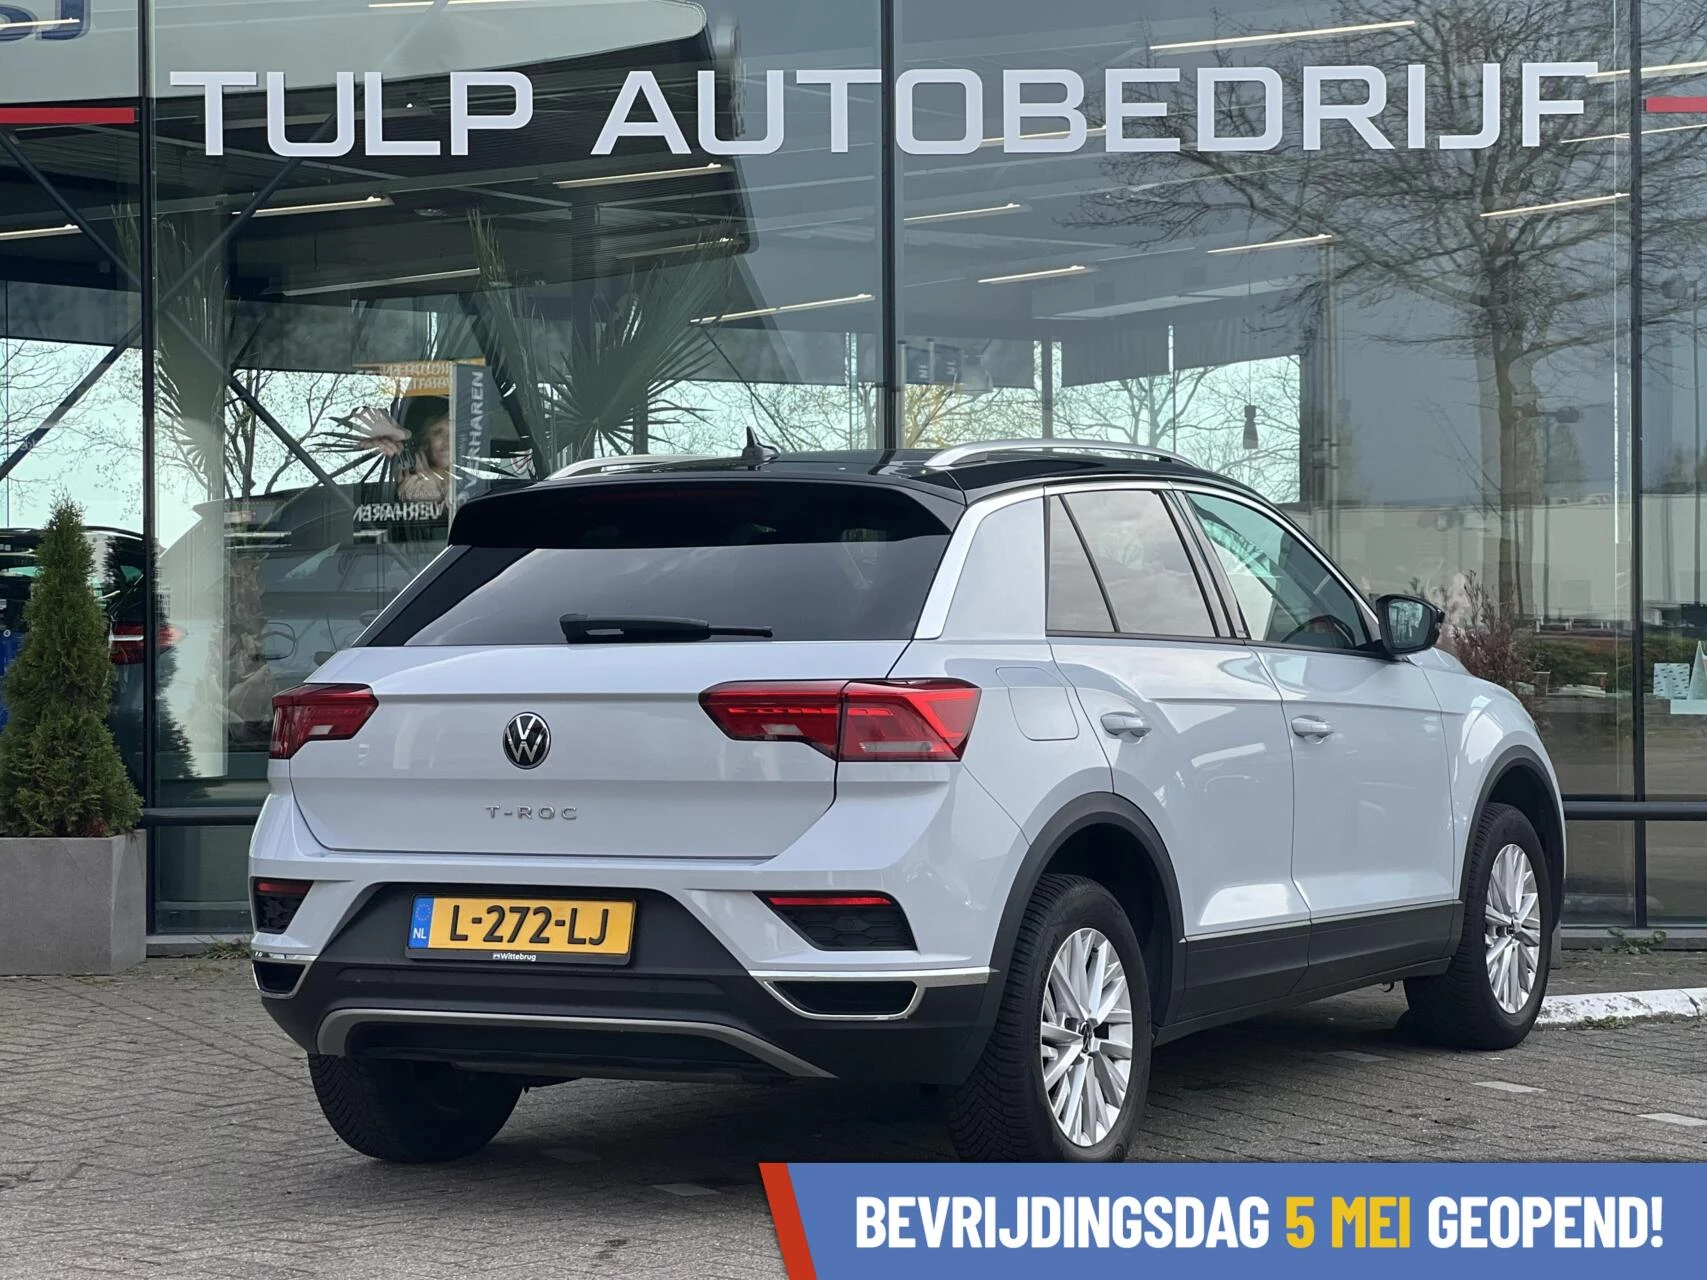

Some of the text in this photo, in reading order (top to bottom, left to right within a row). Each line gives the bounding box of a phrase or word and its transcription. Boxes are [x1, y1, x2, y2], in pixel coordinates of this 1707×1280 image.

[170, 61, 1599, 157] TULP AUTOBEDRIJF
[486, 805, 578, 820] T-ROC
[449, 904, 610, 947] L-272-LJ
[412, 928, 427, 940] NL
[500, 952, 537, 962] Wittebrug
